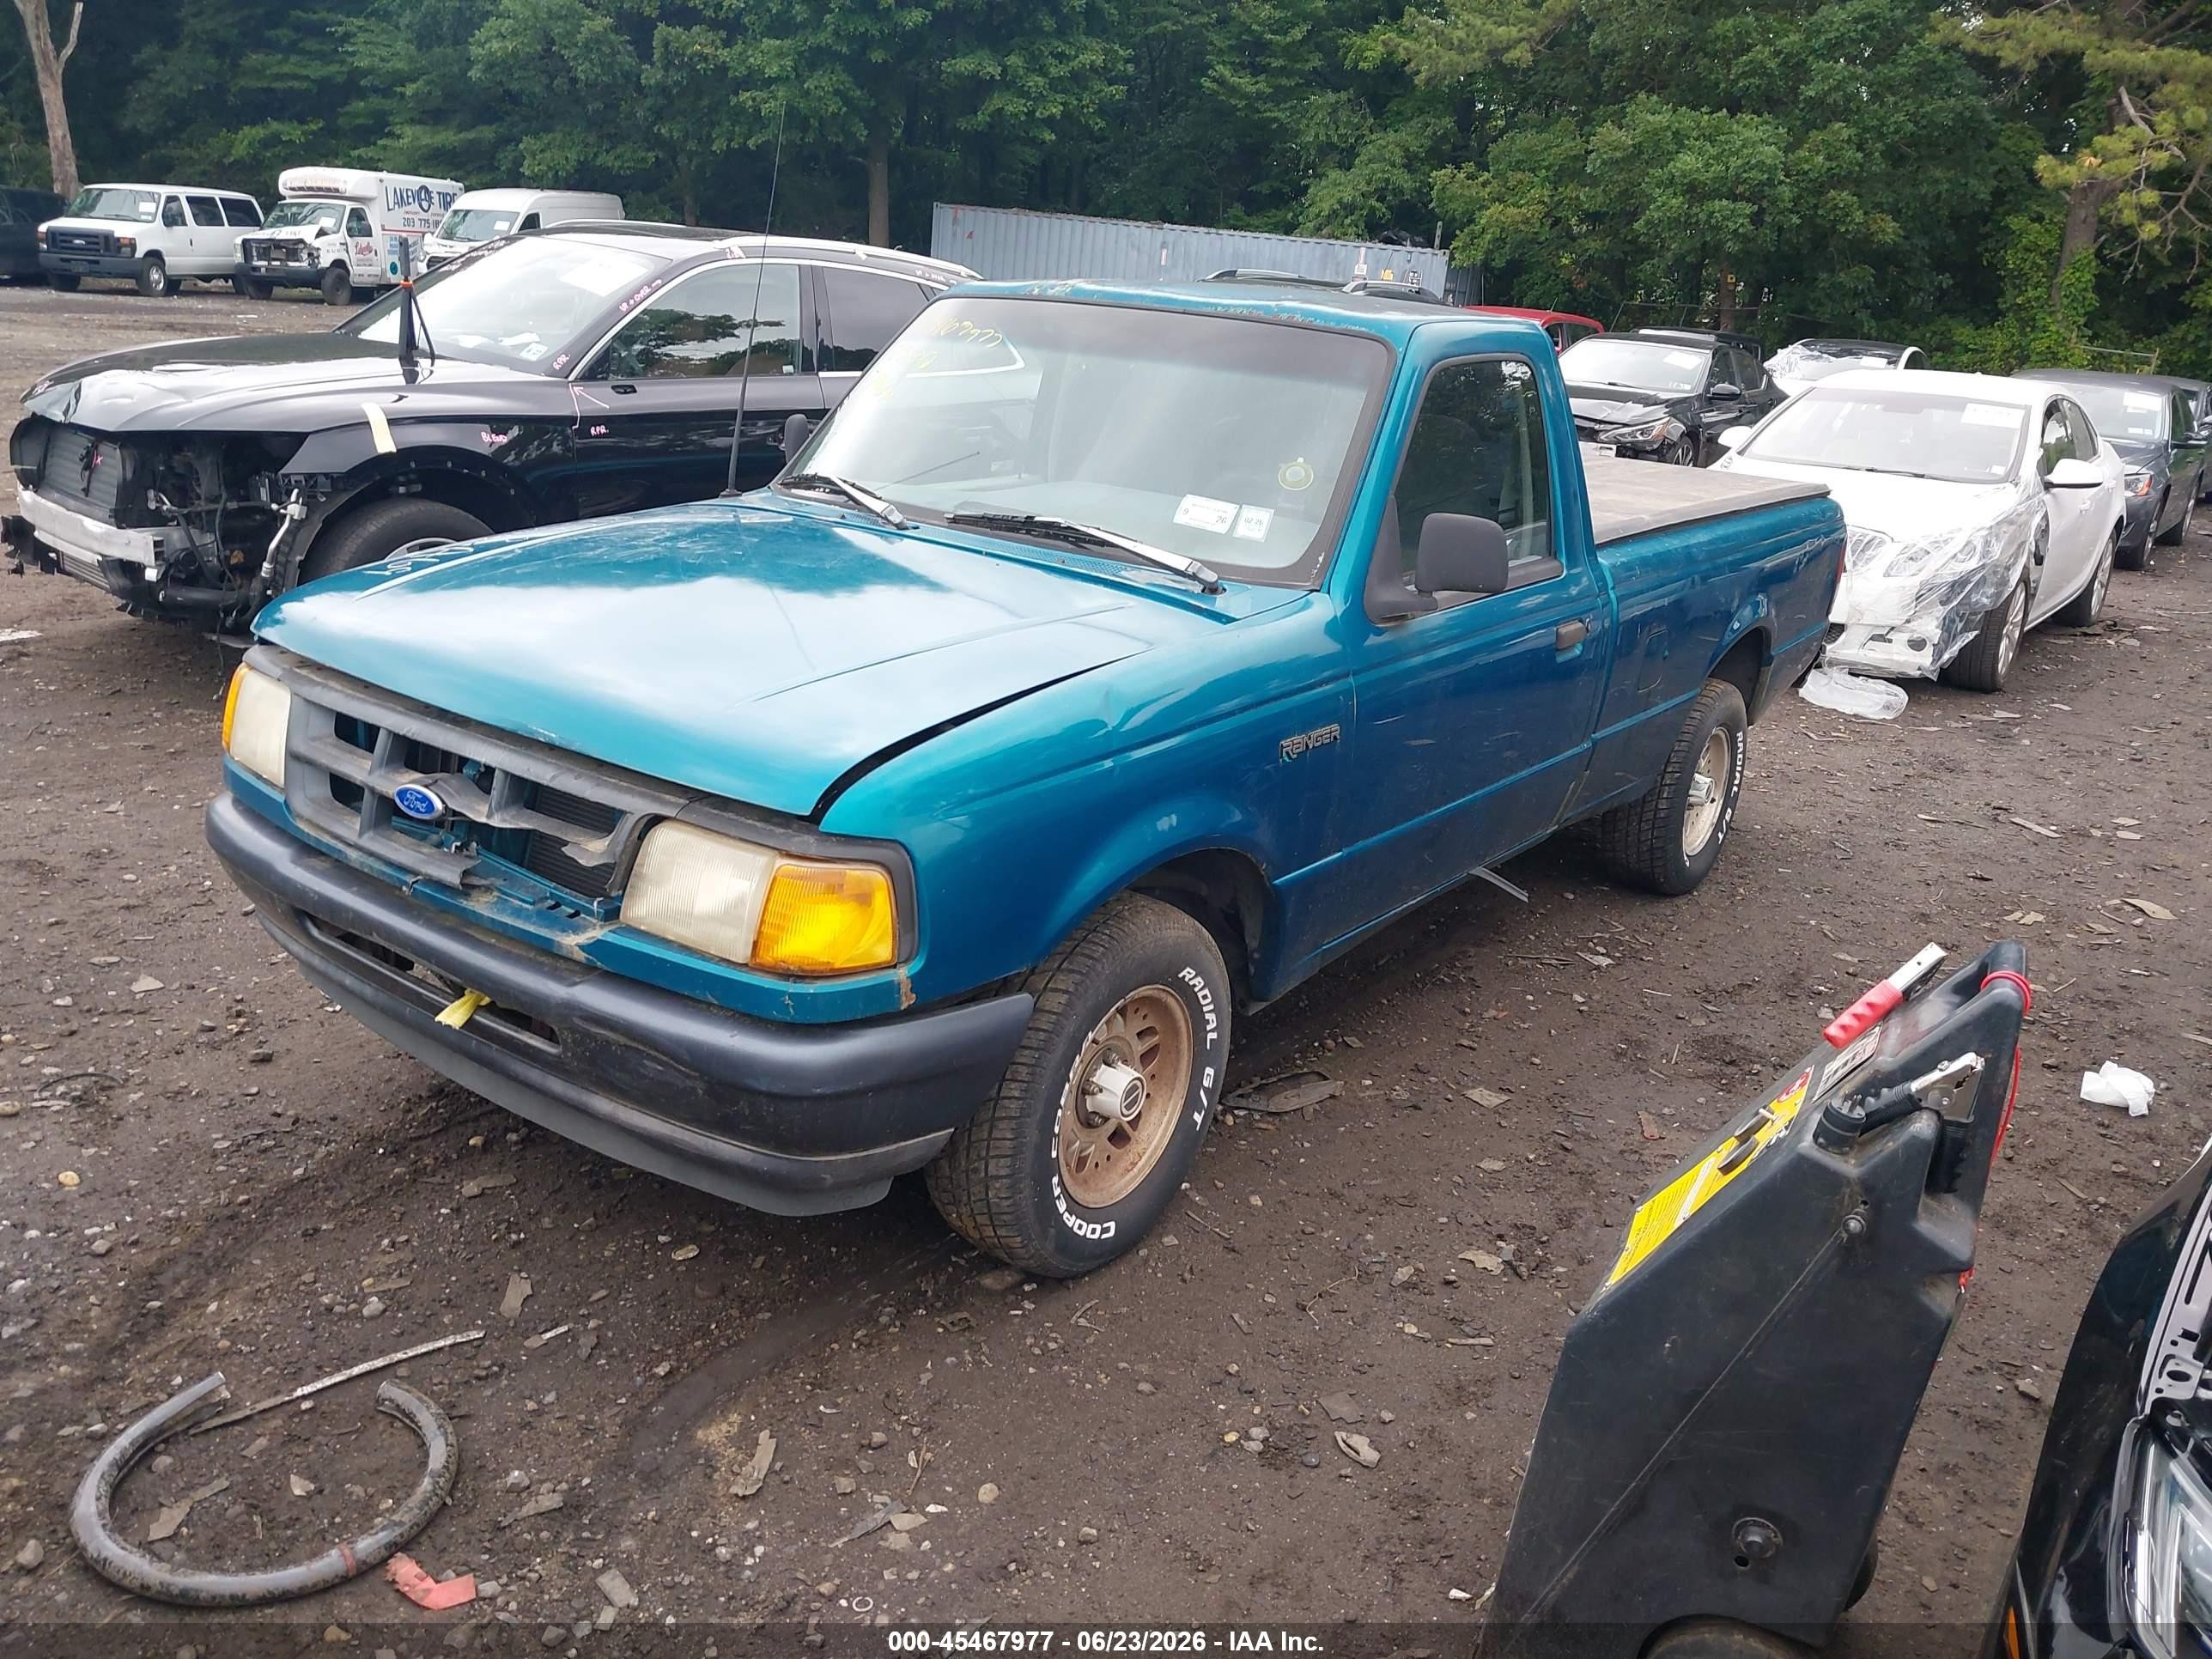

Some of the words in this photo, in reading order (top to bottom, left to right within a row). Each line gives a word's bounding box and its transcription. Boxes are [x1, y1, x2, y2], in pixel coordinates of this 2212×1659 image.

[402, 217, 416, 228] 203
[418, 218, 430, 229] 775
[1279, 723, 1340, 763] RANGER
[1730, 731, 1744, 798] RADIAL
[403, 789, 429, 813] Ford
[1051, 1173, 1116, 1240] COOPER
[1177, 966, 1218, 1050] RADIAL
